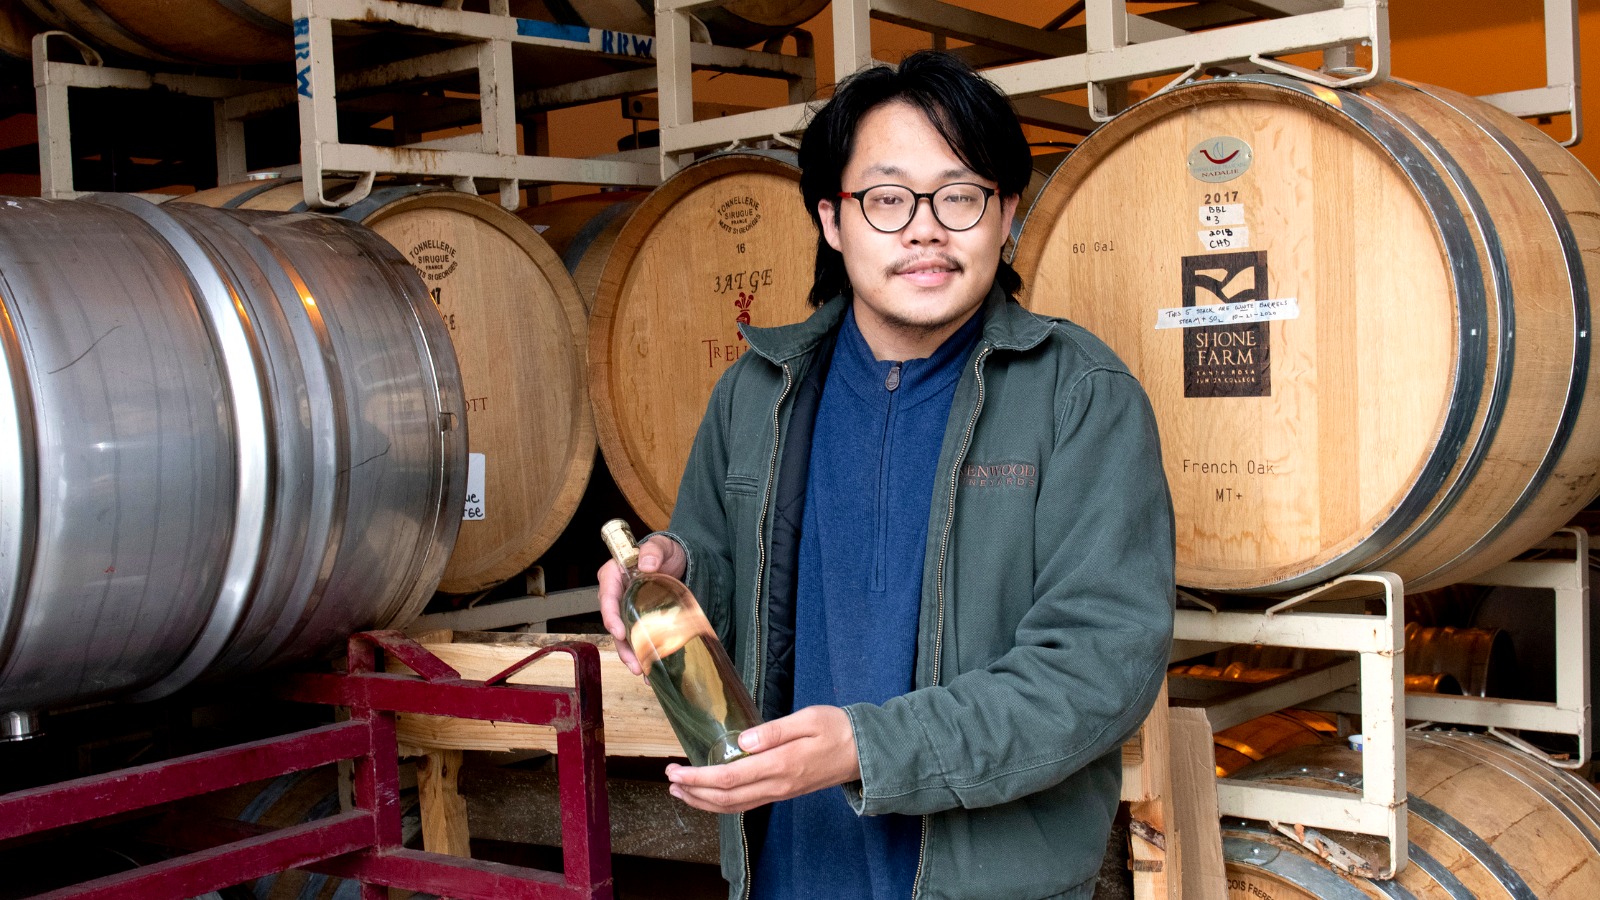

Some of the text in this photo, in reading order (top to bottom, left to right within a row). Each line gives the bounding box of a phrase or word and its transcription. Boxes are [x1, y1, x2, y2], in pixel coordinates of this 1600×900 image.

[602, 29, 653, 57] RRW
[1204, 191, 1239, 205] 2017
[717, 196, 760, 216] TONNELLERIE
[1208, 206, 1227, 214] BBL
[725, 208, 753, 220] SIRUGUE
[409, 239, 457, 259] TONNELLERIE
[736, 243, 746, 254] 16
[1072, 240, 1115, 254] 60 Gal
[418, 254, 450, 264] SIRUGUE
[434, 260, 458, 281] GEORGES
[1196, 331, 1257, 348] SHONE
[1198, 348, 1255, 366] FARM
[1183, 459, 1275, 475] French Oak
[962, 477, 1035, 487] NEYARDS
[1215, 488, 1243, 502] MT+
[1247, 883, 1275, 900] FRERE
